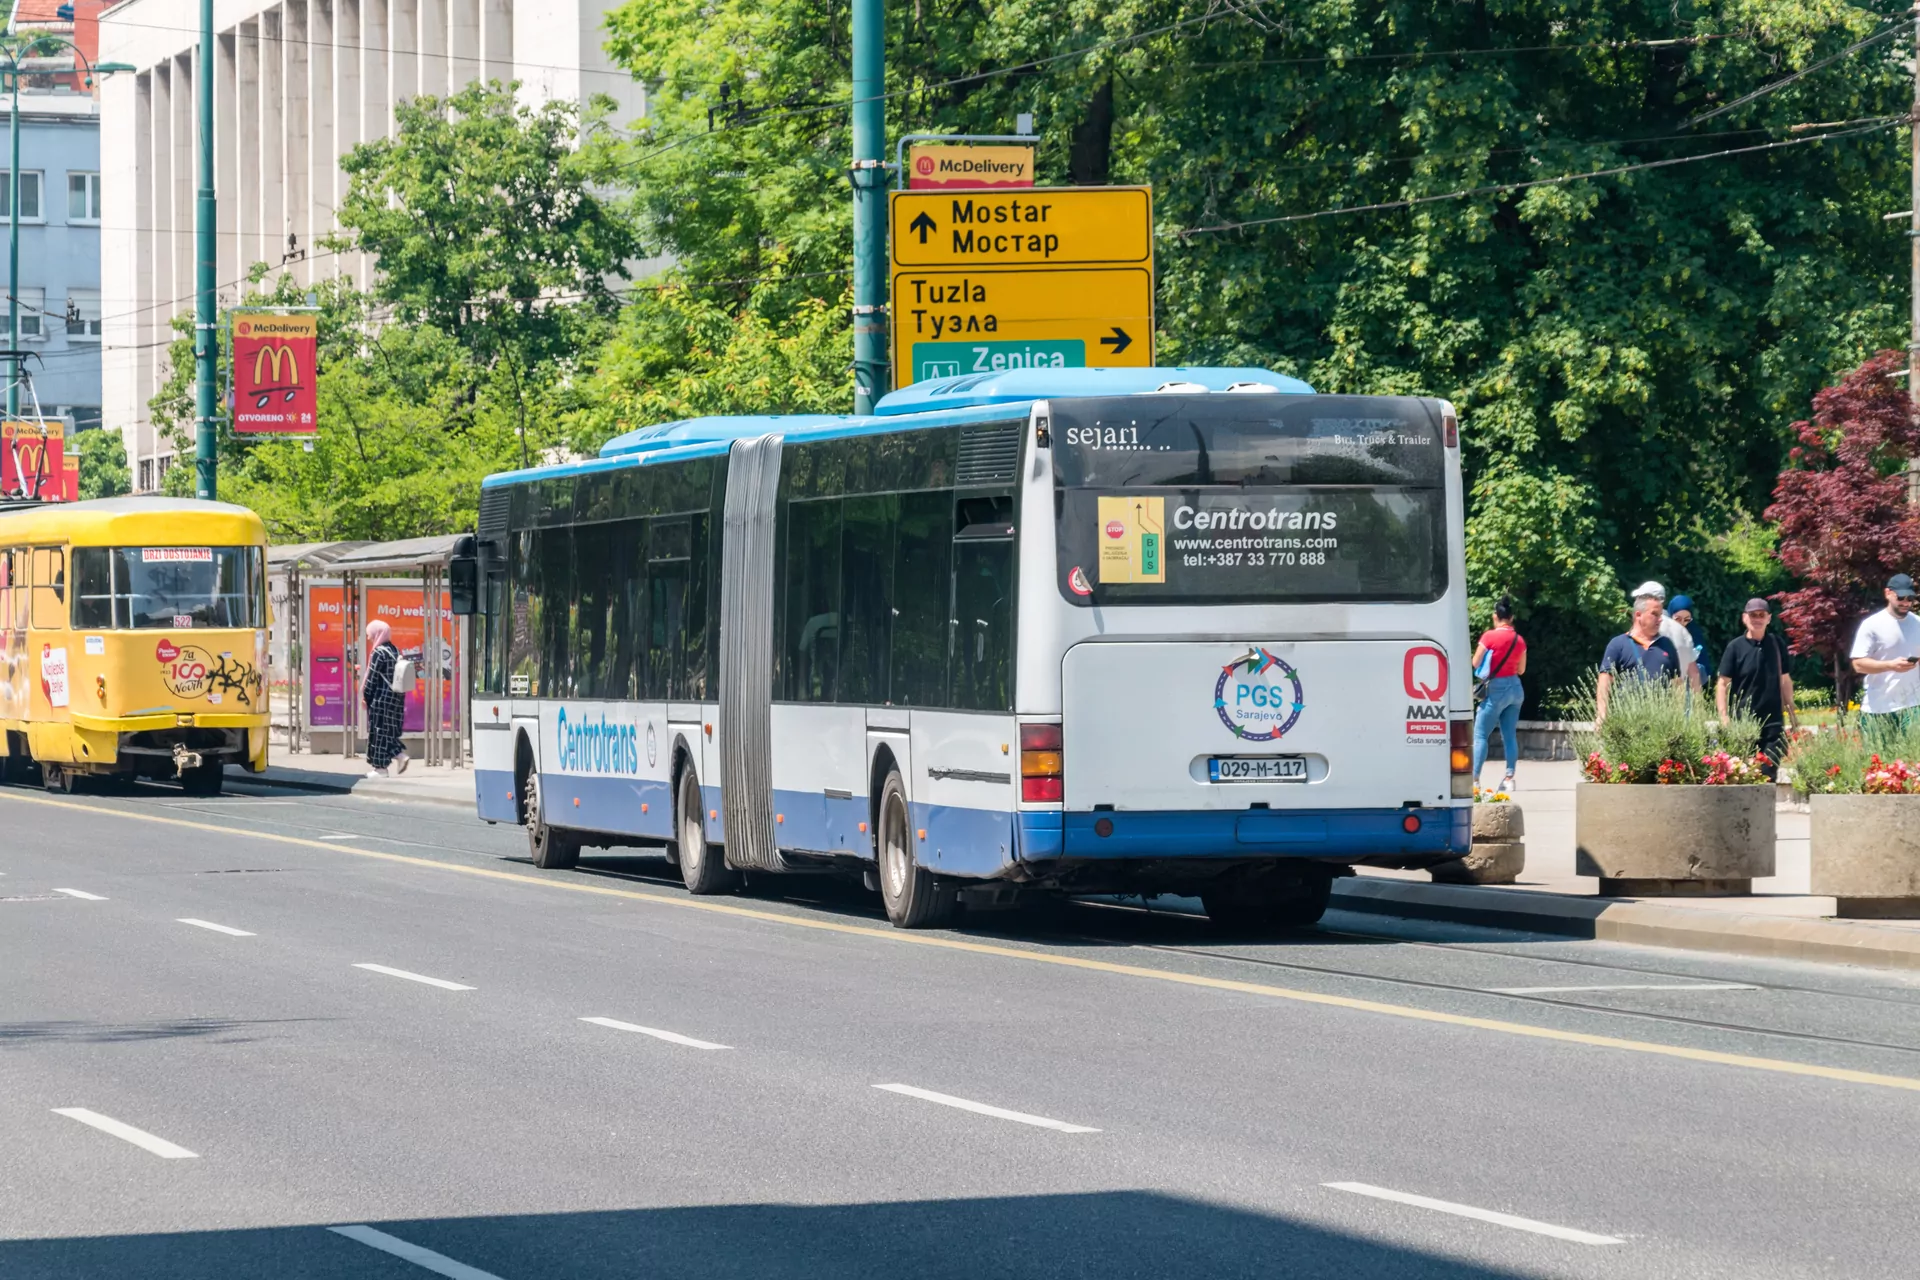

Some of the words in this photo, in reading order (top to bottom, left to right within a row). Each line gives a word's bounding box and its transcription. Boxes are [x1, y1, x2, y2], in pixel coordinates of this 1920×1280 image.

[939, 159, 1024, 176] McDelivery
[952, 200, 1052, 224] Mostar
[952, 230, 1059, 258] Мостар
[910, 279, 986, 304] Tuzla
[253, 324, 310, 334] McDelivery
[911, 310, 998, 339] Тузла
[972, 347, 1065, 371] Zenica
[238, 413, 284, 422] OTVORENO
[1067, 420, 1139, 450] sejari
[1357, 435, 1387, 445] Truck
[1388, 435, 1396, 445] &
[1397, 435, 1431, 445] Trailer
[1173, 505, 1337, 530] Centrotrans
[1174, 536, 1338, 549] www.centrotrans.com
[164, 547, 211, 560] ODSTOJANJE
[1146, 538, 1154, 570] BUS
[1183, 553, 1243, 567] tel:+387
[1247, 553, 1265, 566] 33
[1269, 553, 1295, 566] 770
[1299, 552, 1326, 566] 888
[318, 601, 340, 615] Moj
[377, 603, 400, 618] Moj
[175, 616, 191, 628] 522
[182, 650, 196, 662] Za
[1403, 646, 1448, 702] Q
[1236, 684, 1283, 708] PGS
[1236, 709, 1283, 722] Sarajevo
[1406, 705, 1446, 720] MAX
[557, 706, 637, 775] Centrotrans
[1221, 761, 1302, 778] 029-M-117
